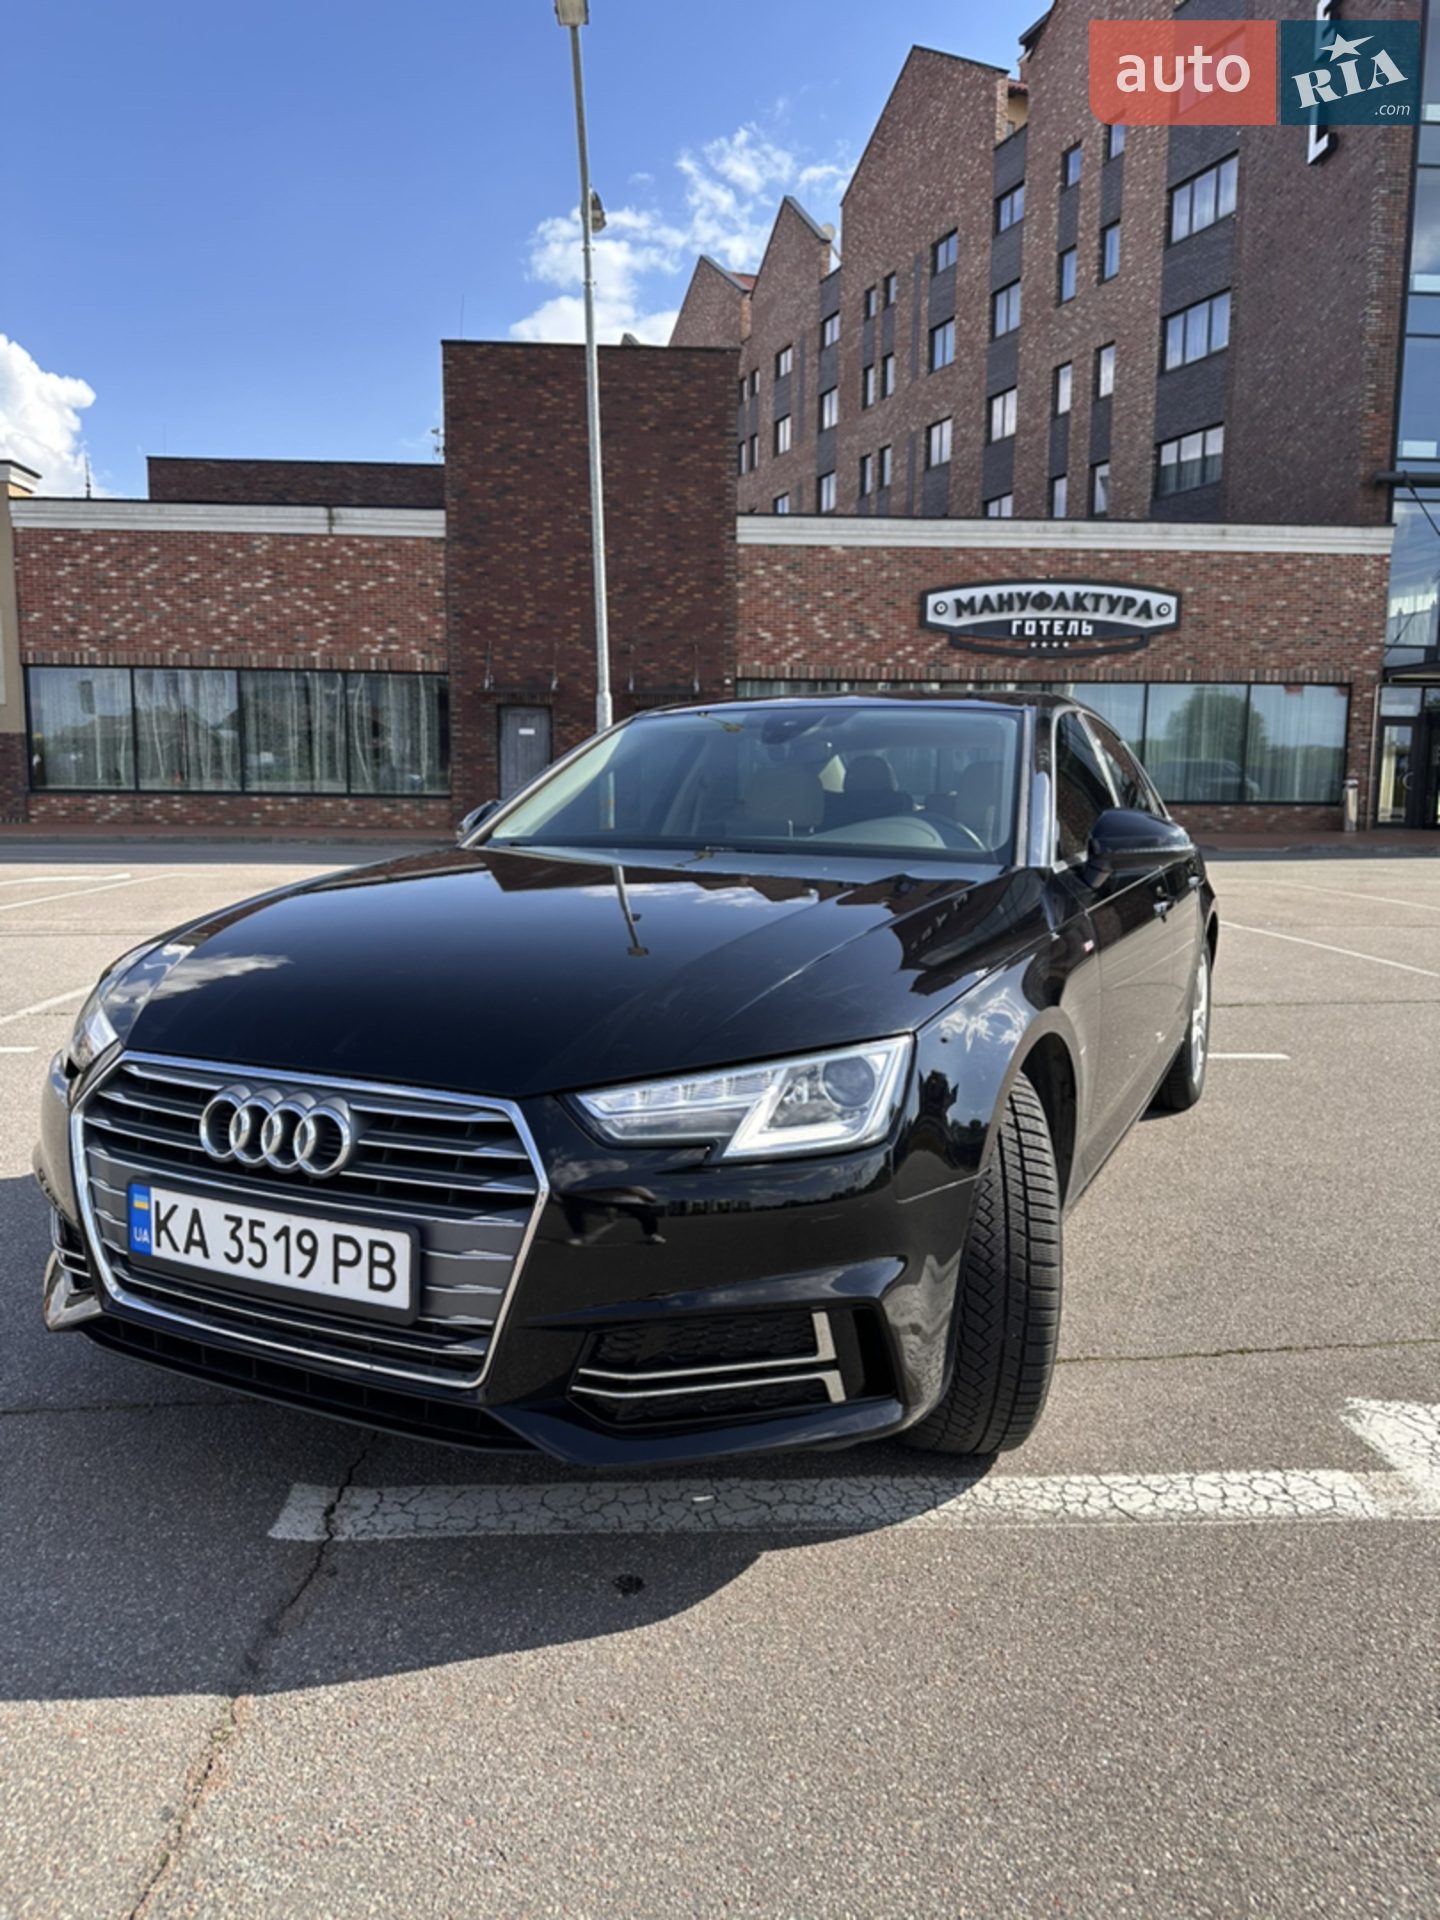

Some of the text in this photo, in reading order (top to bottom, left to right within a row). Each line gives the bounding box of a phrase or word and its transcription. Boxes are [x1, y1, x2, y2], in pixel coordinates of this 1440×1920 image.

[954, 591, 1154, 620] МАНУФАКТУРА
[1011, 620, 1093, 636] ГОТЕЛЬ
[133, 1226, 150, 1244] UA
[154, 1200, 397, 1293] KA 3519 PB
